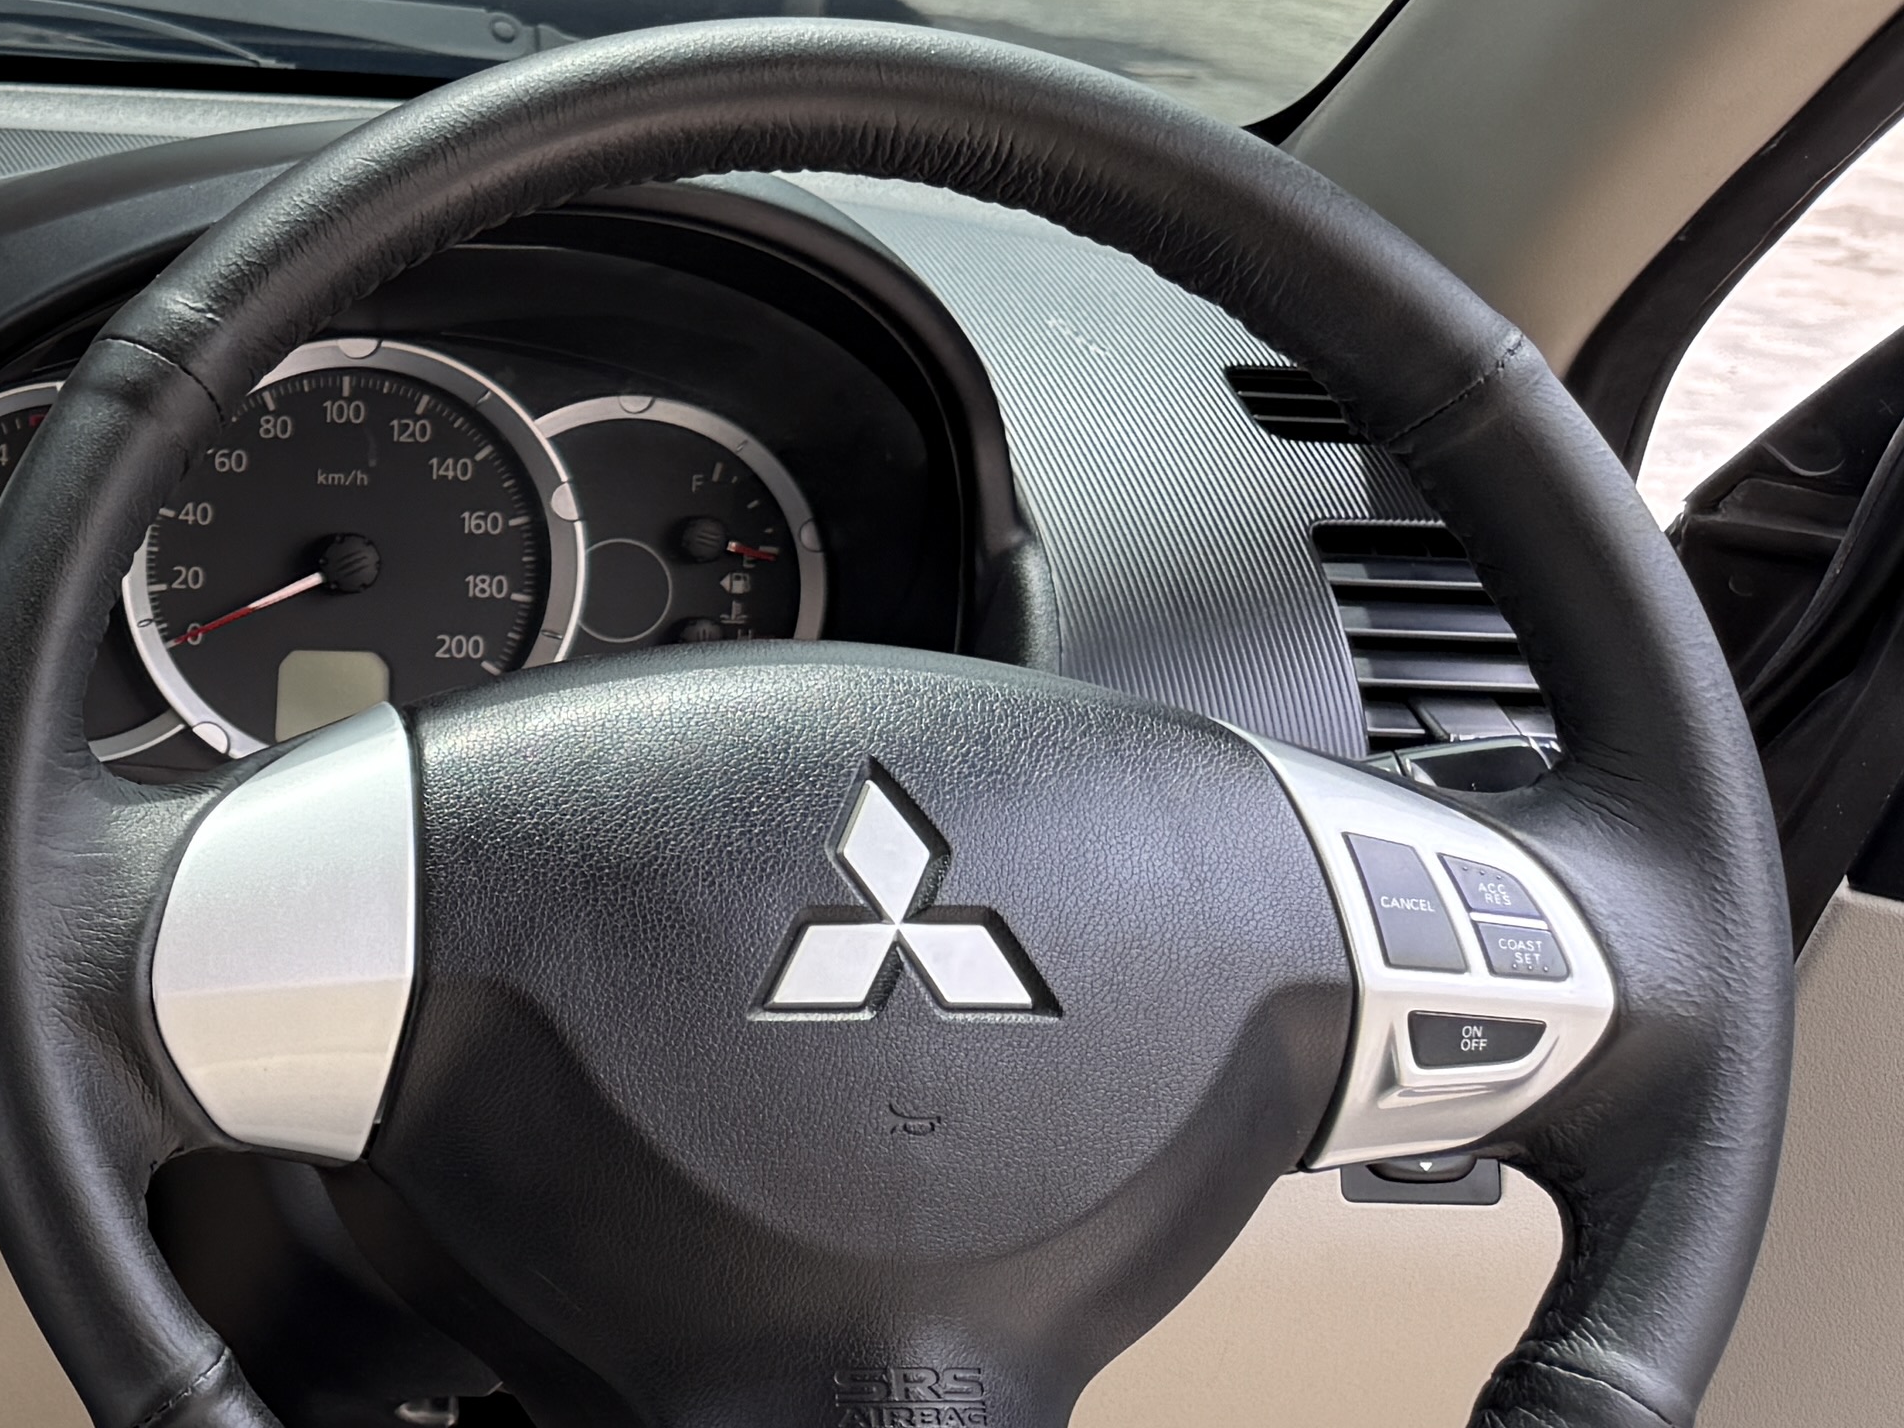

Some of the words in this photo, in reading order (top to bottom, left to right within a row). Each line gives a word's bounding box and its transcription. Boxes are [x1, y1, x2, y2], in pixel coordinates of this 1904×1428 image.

[323, 399, 366, 423] 100
[258, 416, 293, 440] 80
[389, 419, 432, 443] 120
[213, 449, 248, 473] 60
[428, 457, 473, 482] 140
[316, 468, 369, 487] km/h
[691, 474, 704, 493] F
[178, 501, 213, 526] 40
[459, 510, 503, 535] 160
[171, 566, 205, 591] 20
[464, 574, 509, 599] 180
[186, 622, 203, 646] 0
[434, 634, 485, 659] 200
[1478, 882, 1507, 895] ACC
[1485, 893, 1512, 906] RES
[1380, 895, 1436, 913] CANCEL
[1498, 938, 1543, 952] COAST
[1514, 951, 1541, 964] SET
[1461, 1025, 1483, 1038] ON
[1460, 1038, 1488, 1052] OFF
[833, 1366, 985, 1401] SRS
[837, 1406, 988, 1428] AIRBAG
